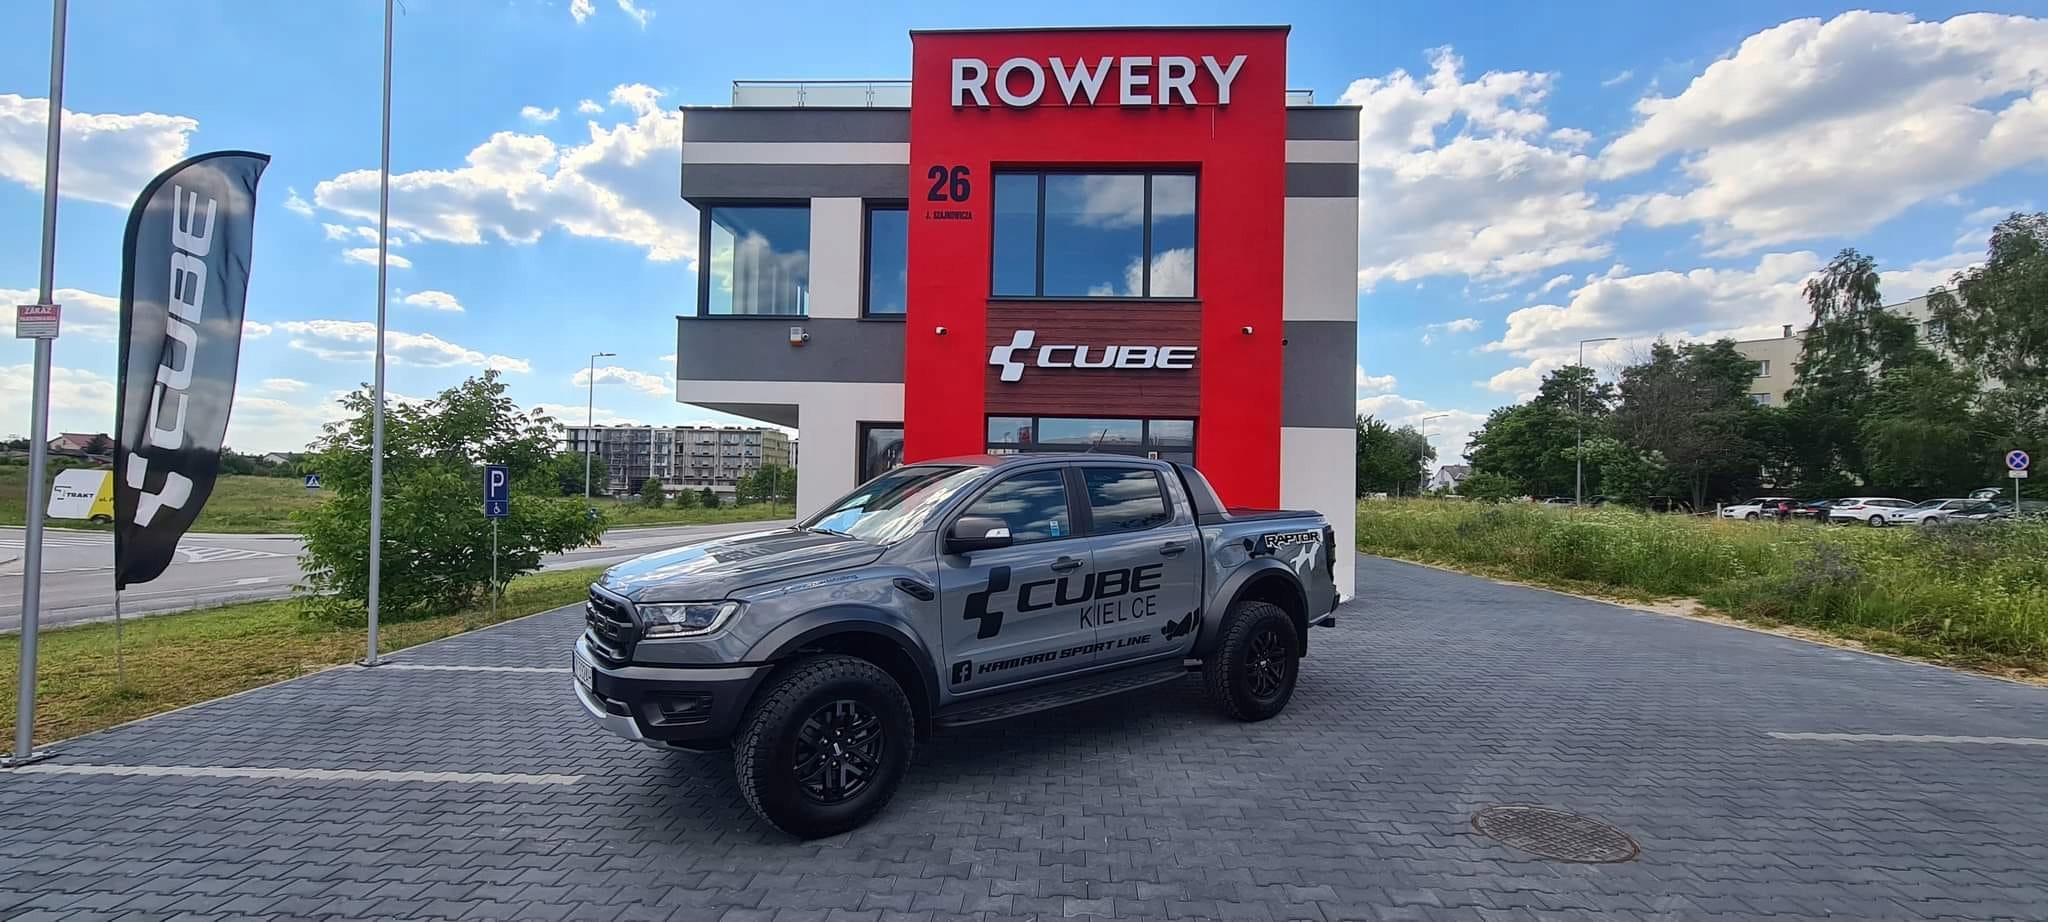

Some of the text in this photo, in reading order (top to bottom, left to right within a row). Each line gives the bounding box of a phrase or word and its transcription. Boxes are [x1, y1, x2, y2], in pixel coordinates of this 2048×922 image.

[951, 55, 1248, 107] ROWERY
[927, 165, 971, 202] 26
[150, 184, 217, 450] CUBE
[1036, 345, 1198, 370] CUBE
[491, 470, 504, 498] P
[1265, 531, 1320, 548] RAPTOR
[1017, 563, 1163, 613] CUBE
[1080, 594, 1157, 630] KIELCE
[1059, 640, 1115, 659] SPORT
[1117, 634, 1151, 648] LINE
